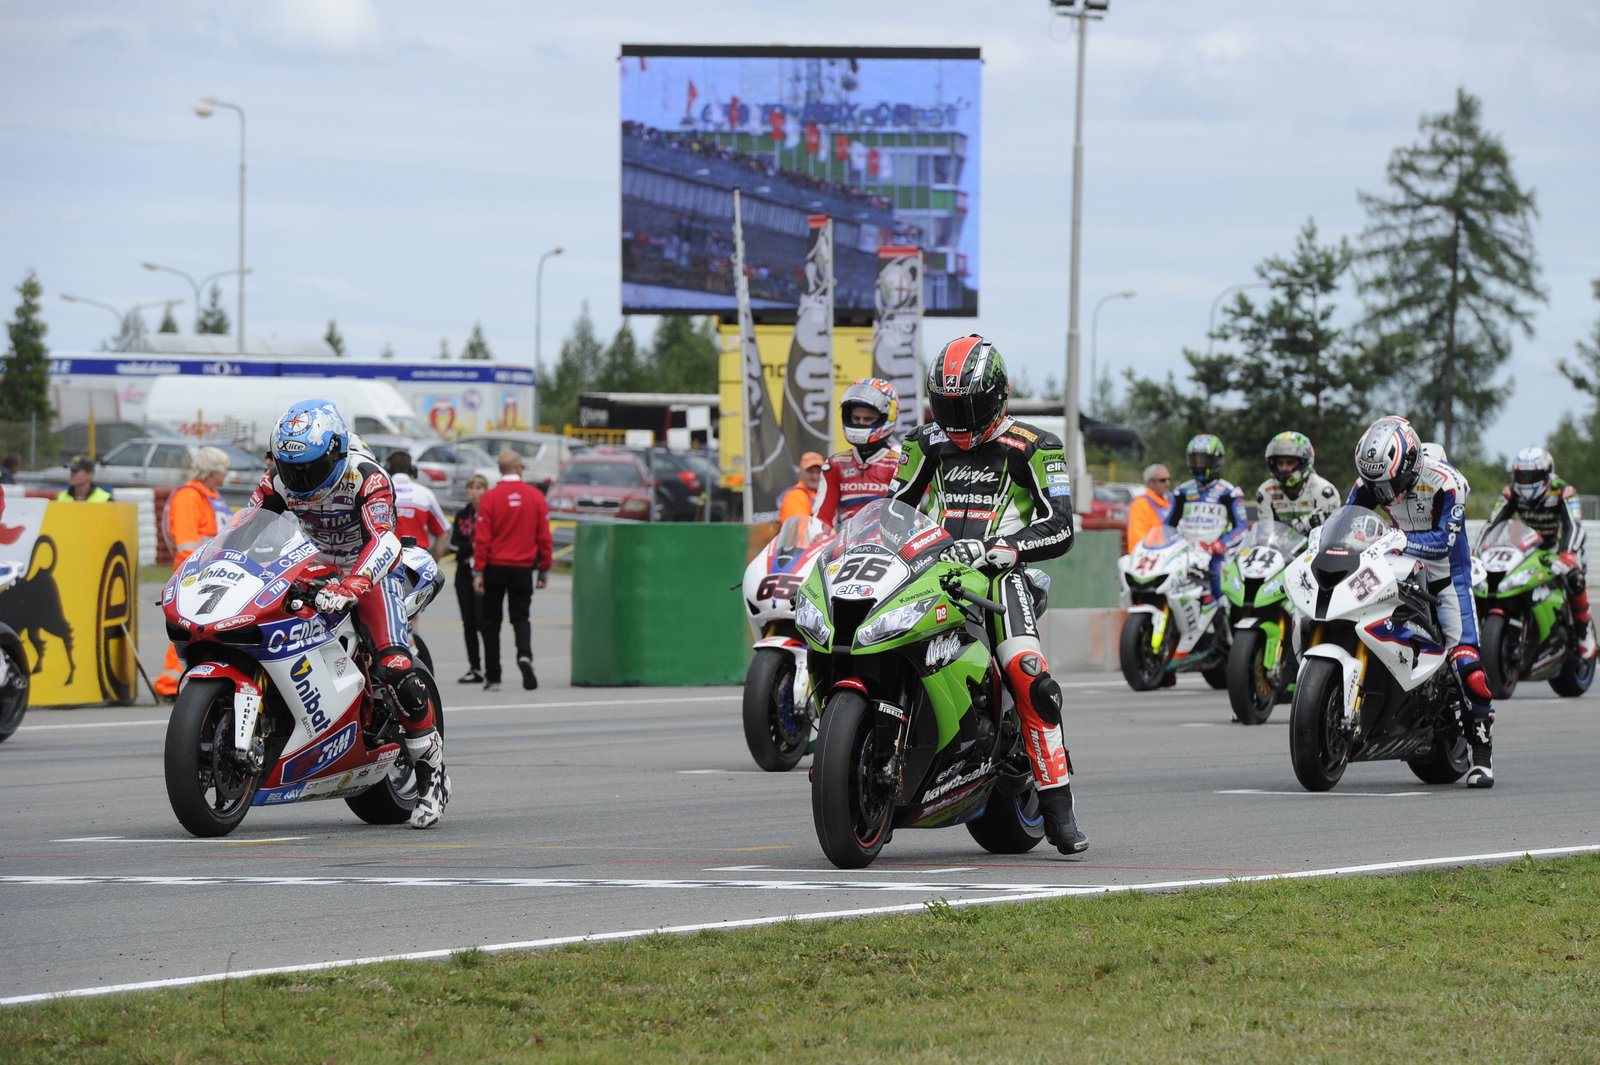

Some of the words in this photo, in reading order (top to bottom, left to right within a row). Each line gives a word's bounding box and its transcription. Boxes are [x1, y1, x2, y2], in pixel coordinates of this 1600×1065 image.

[1359, 458, 1387, 472] NOLAN
[944, 465, 999, 486] Ninja
[840, 483, 889, 492] HONDA
[938, 492, 1007, 506] Kawasaki
[320, 514, 351, 527] TIM
[944, 510, 992, 519] Motocard
[1194, 505, 1221, 516] FIXI
[911, 529, 942, 551] Motocard
[1017, 526, 1072, 552] Kawasaki
[223, 552, 243, 561] TIM
[1243, 548, 1277, 568] 44
[197, 567, 246, 582] Unibat
[832, 556, 892, 585] 66
[269, 581, 287, 595] TIM
[757, 575, 804, 601] 65
[836, 585, 858, 596] elf
[1349, 568, 1381, 601] 33
[195, 584, 230, 615] 7
[899, 588, 934, 604] Kawasaki
[1011, 573, 1036, 635] Kawasaki
[926, 628, 961, 666] Ninja
[290, 655, 332, 733] Unibat
[240, 696, 253, 737] PIRELLI
[377, 748, 400, 761] DUCATI
[921, 757, 992, 804] Kawasaki
